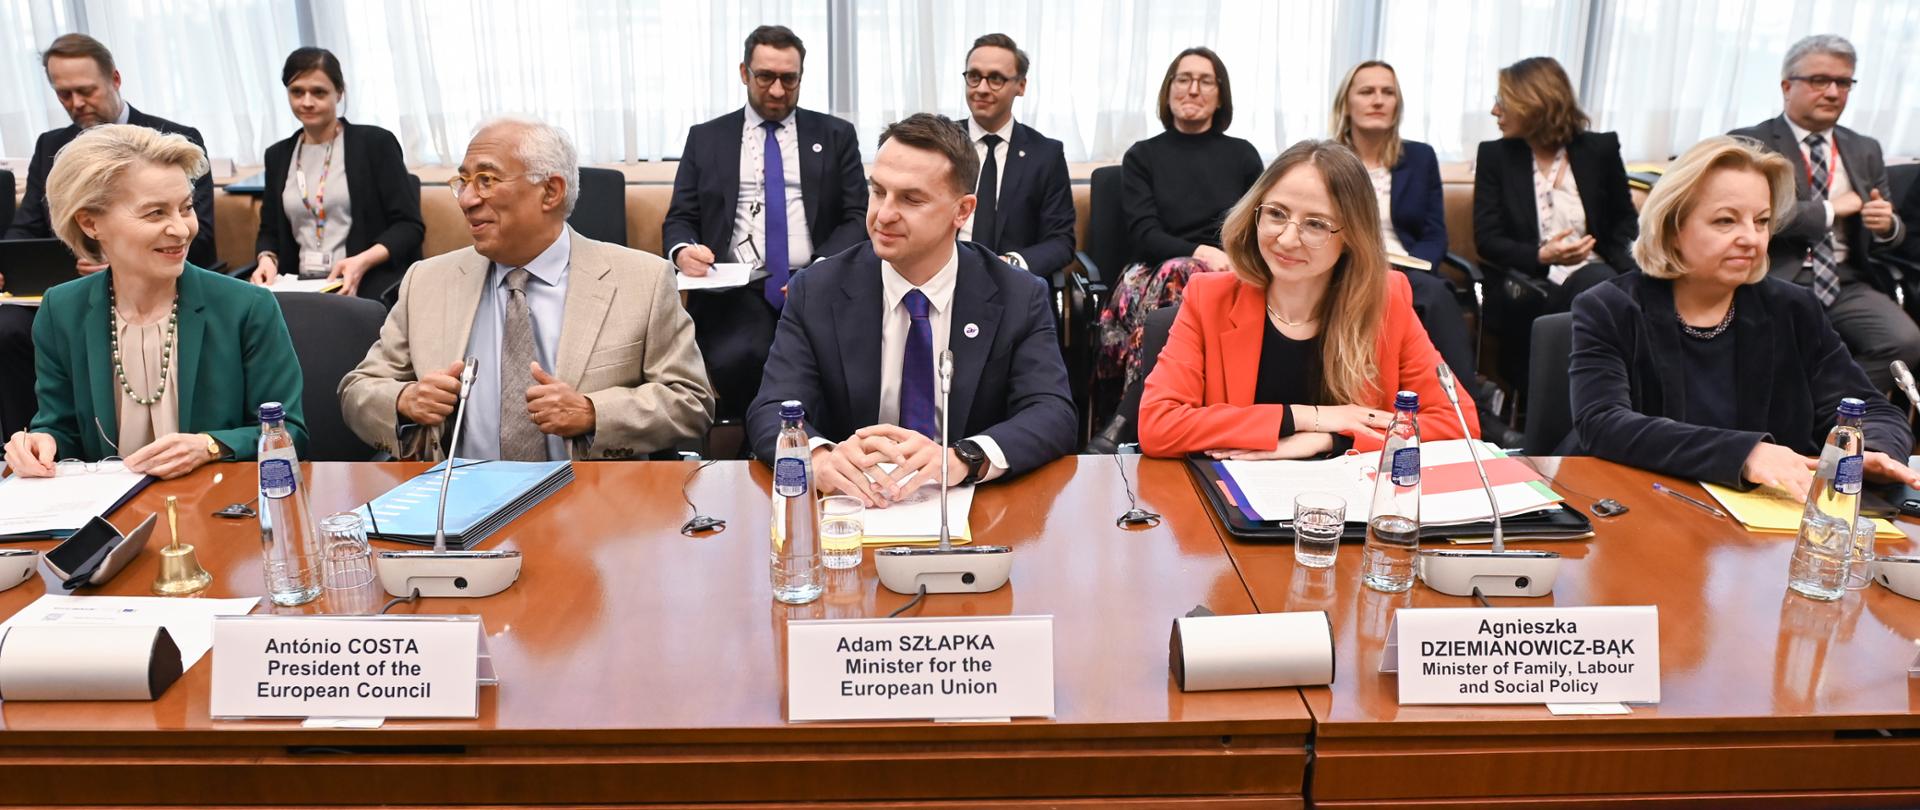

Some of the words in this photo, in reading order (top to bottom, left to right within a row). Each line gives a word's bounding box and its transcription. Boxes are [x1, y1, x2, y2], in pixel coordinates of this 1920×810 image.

[1478, 618, 1577, 638] Agnieszka
[265, 637, 341, 655] António
[348, 638, 418, 655] COSTA
[836, 636, 892, 653] Adam
[899, 635, 995, 652] SZŁAPKA
[1421, 639, 1635, 658] DZIEMIANOWICZ-BĄK
[268, 660, 360, 677] President
[366, 660, 387, 677] of
[391, 660, 421, 677] the
[845, 658, 923, 675] Minister
[928, 657, 957, 673] for
[962, 657, 992, 673] the
[1422, 662, 1488, 676] Minister
[1493, 661, 1510, 675] of
[1514, 660, 1572, 678] Family,
[1577, 660, 1635, 674] Labour
[257, 682, 350, 701] European
[356, 682, 431, 698] Council
[841, 680, 934, 700] European
[941, 679, 997, 695] Union
[1459, 680, 1489, 694] and
[1494, 680, 1544, 694] Social
[1549, 679, 1599, 695] Policy
